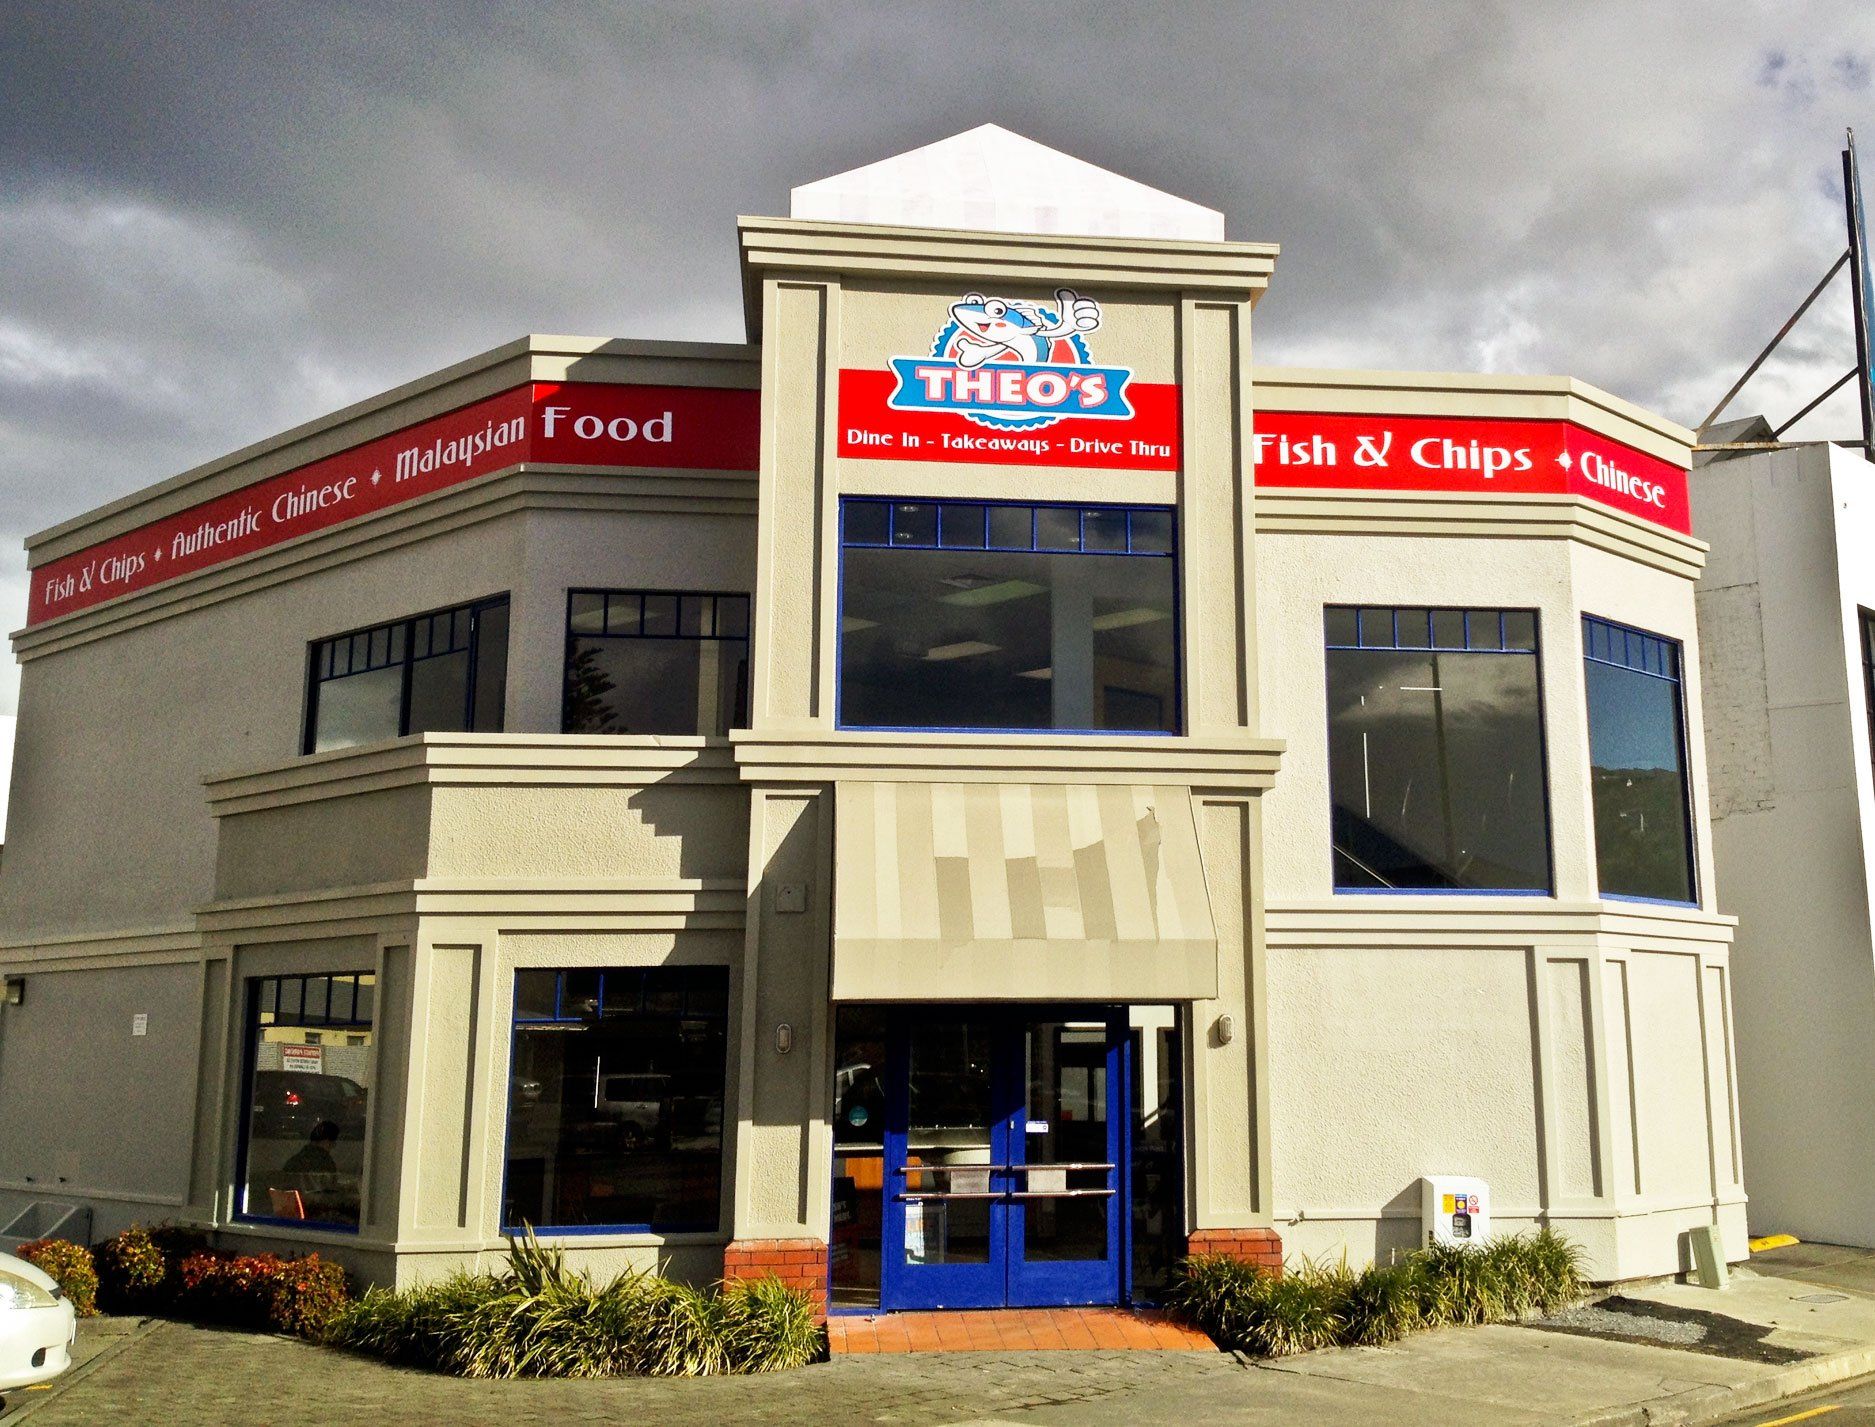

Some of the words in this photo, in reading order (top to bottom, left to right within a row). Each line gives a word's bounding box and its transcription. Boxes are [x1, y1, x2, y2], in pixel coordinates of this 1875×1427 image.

[916, 367, 1107, 407] THEO'S
[541, 406, 673, 443] Food
[847, 428, 894, 446] Dine
[902, 432, 920, 448] In
[941, 433, 1050, 455] Takeaways
[1070, 437, 1123, 454] Drive
[1129, 440, 1171, 457] Thru
[1253, 433, 1337, 466] Fish
[1353, 430, 1393, 467] &
[1410, 437, 1533, 479] Chips
[1579, 450, 1666, 509] Chinese
[45, 573, 75, 605] Fish
[78, 559, 96, 593] &
[100, 551, 146, 585] Chips
[171, 505, 262, 560] Authentic
[271, 475, 357, 523] Chinese
[395, 415, 525, 483] Malaysian
